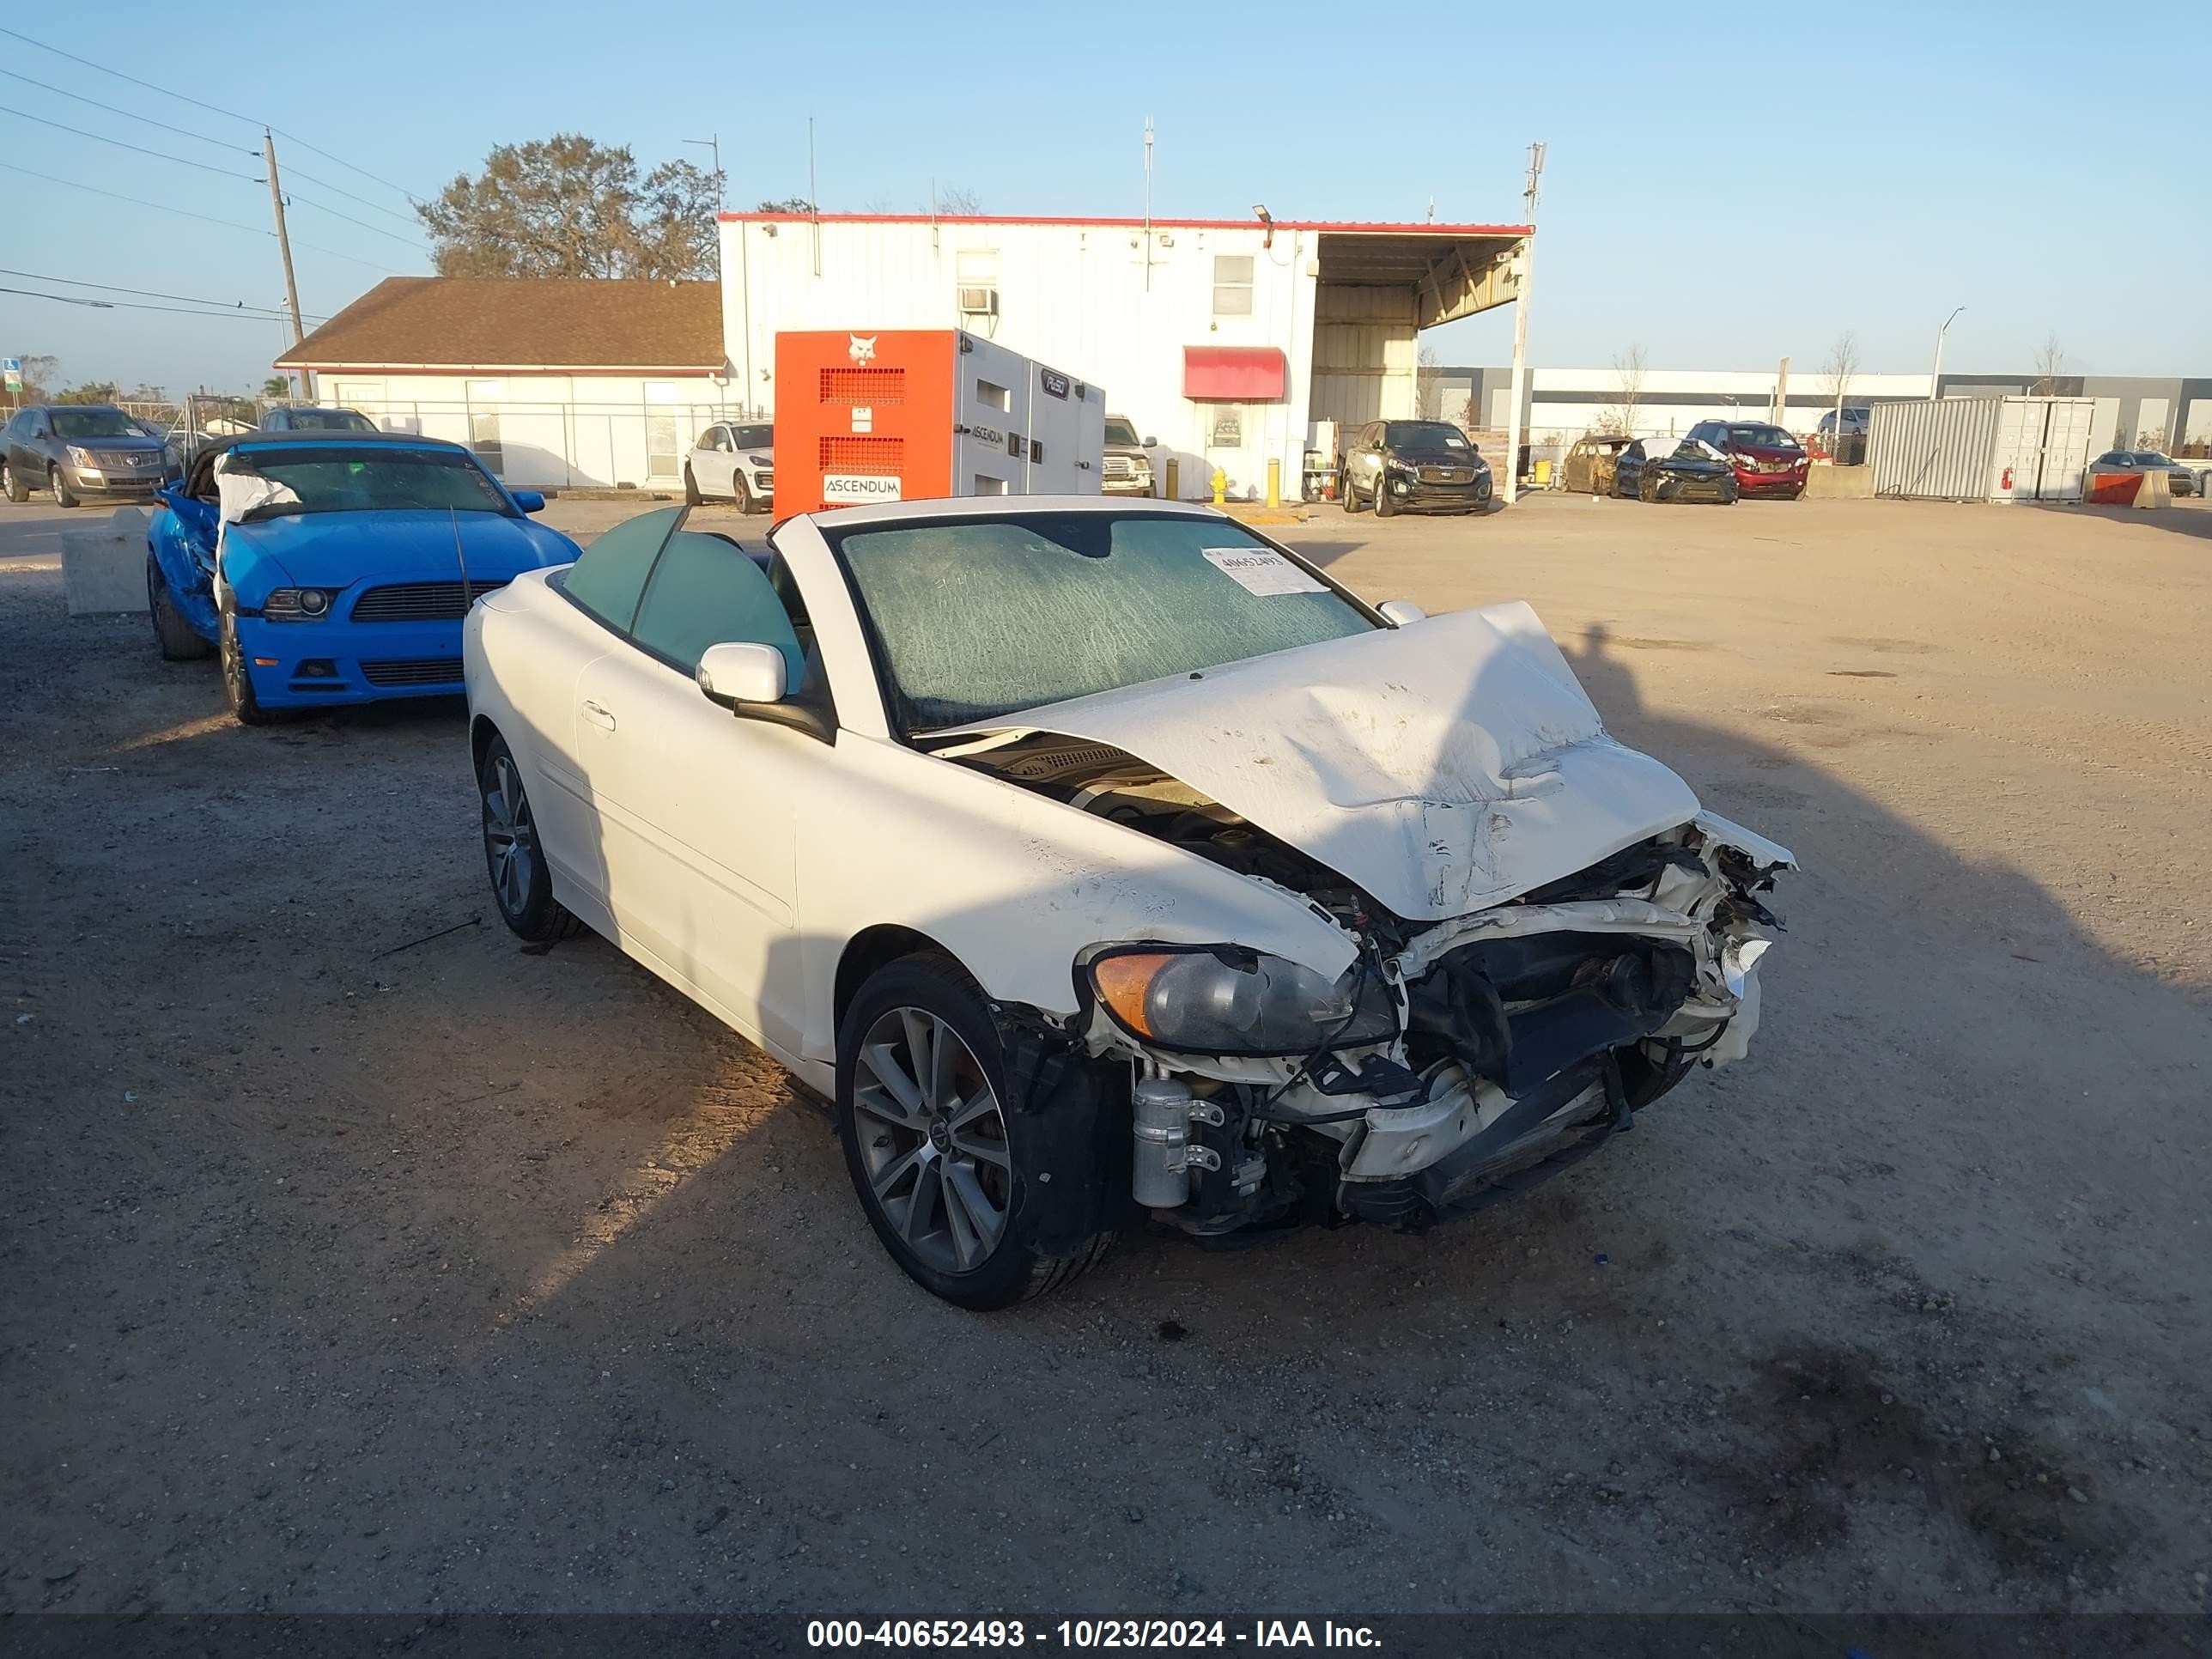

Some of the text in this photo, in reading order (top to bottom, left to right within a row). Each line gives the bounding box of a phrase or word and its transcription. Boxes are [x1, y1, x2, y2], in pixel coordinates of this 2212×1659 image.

[972, 425, 1004, 445] ASCENDUM
[825, 479, 899, 494] ASCENDUM
[1222, 556, 1284, 568] 40652493
